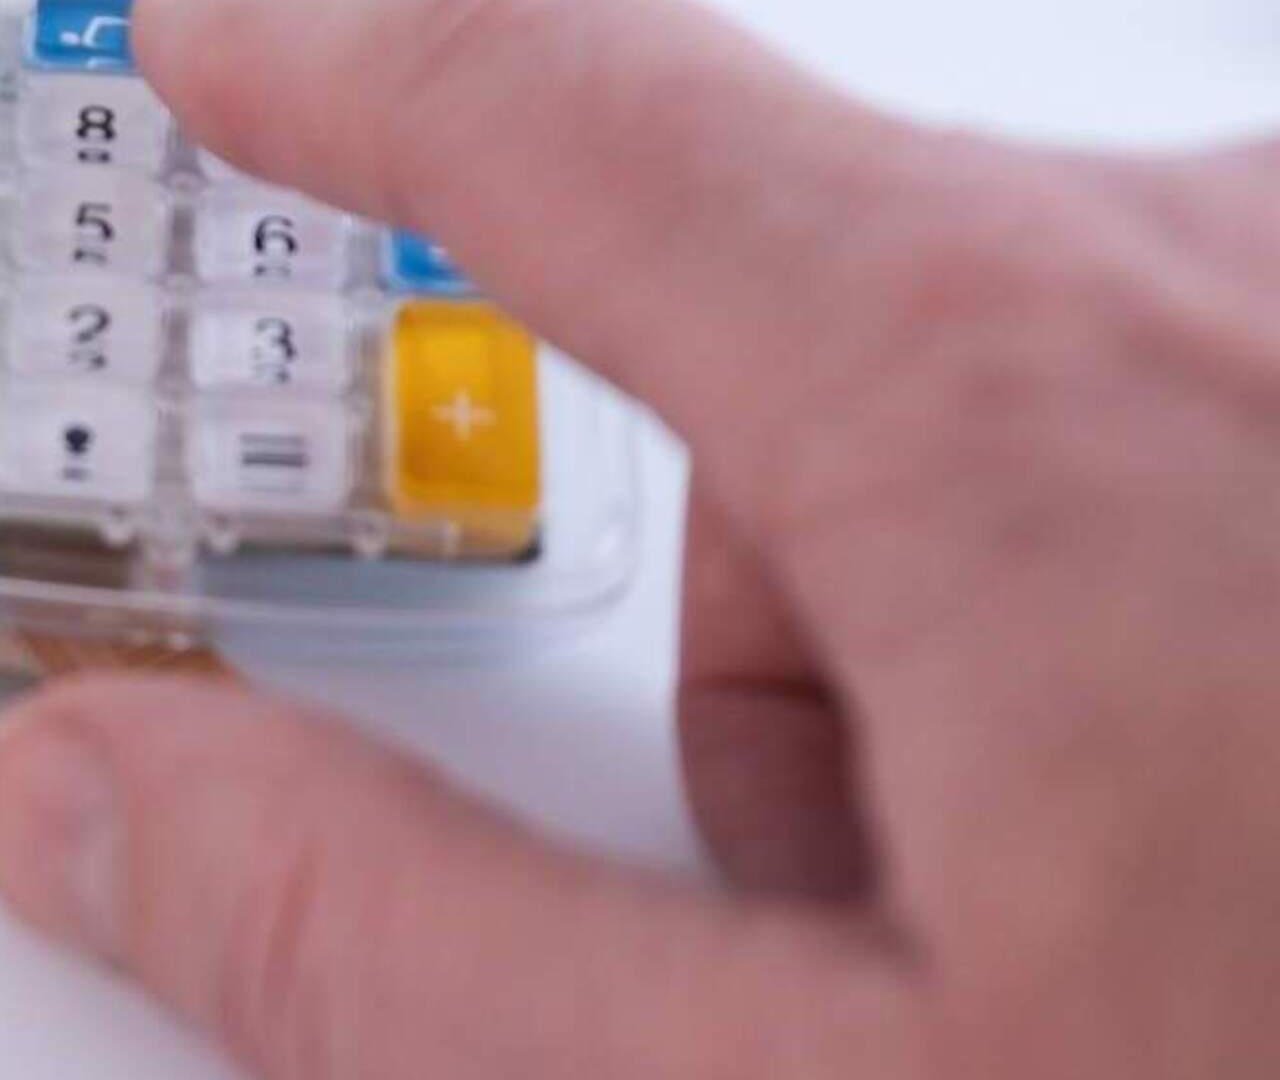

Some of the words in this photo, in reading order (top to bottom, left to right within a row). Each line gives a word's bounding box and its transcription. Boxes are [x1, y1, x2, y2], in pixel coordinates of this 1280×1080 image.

[75, 105, 117, 149] 8
[73, 202, 115, 248] 5
[254, 216, 298, 261] 6
[67, 303, 112, 352] 2
[253, 318, 296, 367] 3
